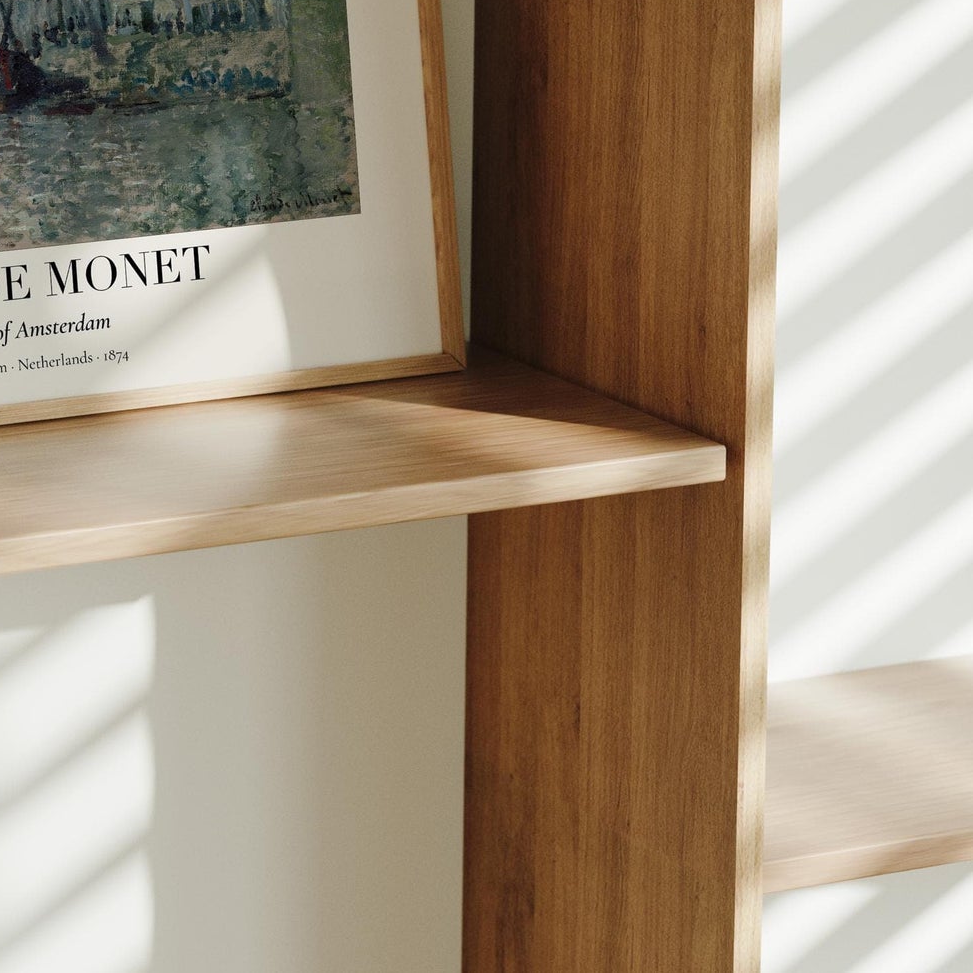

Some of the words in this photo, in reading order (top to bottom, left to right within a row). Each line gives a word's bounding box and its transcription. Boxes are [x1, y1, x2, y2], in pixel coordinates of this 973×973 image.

[45, 245, 211, 297] MONET
[15, 312, 111, 340] Amsterdam
[18, 351, 94, 371] Netherlands
[104, 350, 129, 365] 1874
